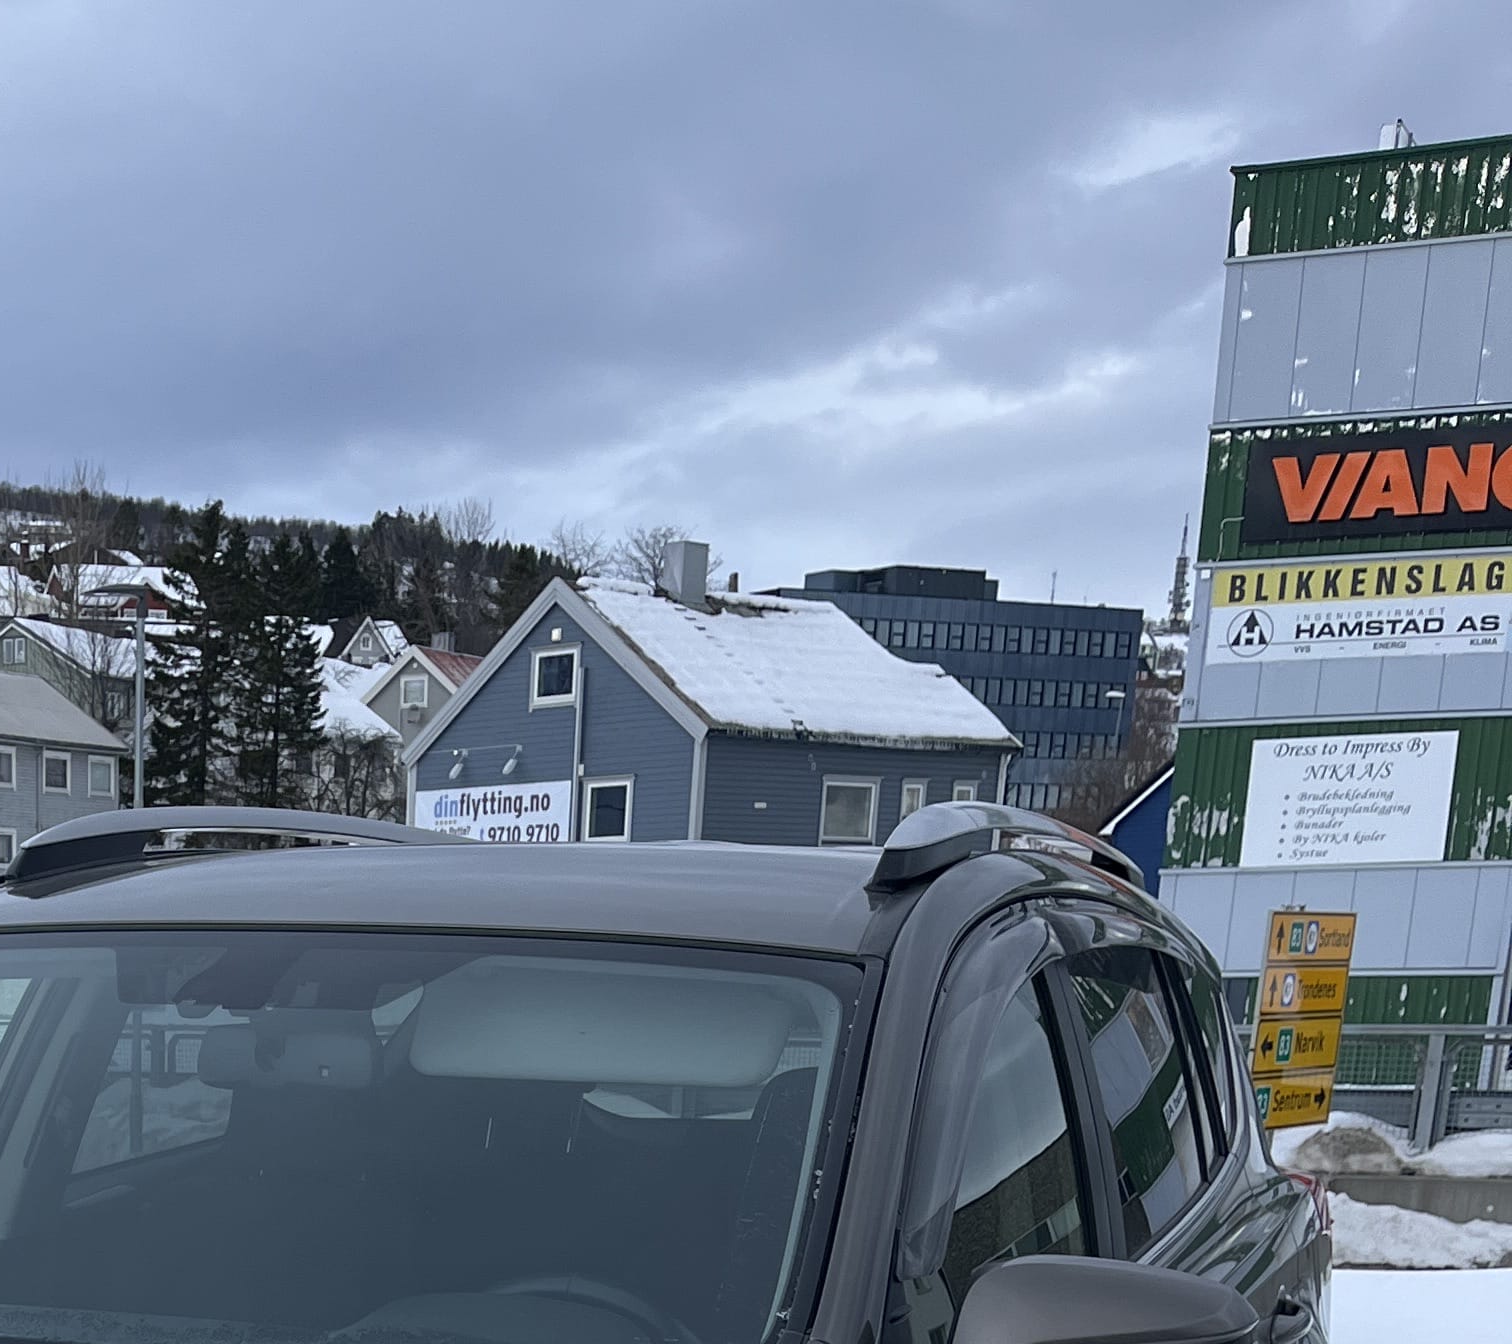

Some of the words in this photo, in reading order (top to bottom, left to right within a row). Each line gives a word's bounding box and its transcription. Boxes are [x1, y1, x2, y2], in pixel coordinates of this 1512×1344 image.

[1228, 560, 1506, 603] BLIKKENSLAG
[1295, 617, 1445, 639] HAMSTAD
[1456, 615, 1500, 632] AS
[1294, 645, 1311, 653] VVS
[1372, 641, 1407, 650] ENERGI
[1469, 637, 1498, 647] KLIMA
[1273, 742, 1318, 758] Dress
[1322, 743, 1338, 755] to
[1342, 740, 1404, 759] Impress
[1406, 737, 1431, 758] By
[1303, 763, 1355, 782] NIKA
[1357, 760, 1394, 781] A/S
[1297, 787, 1395, 802] Brudebekledning
[434, 790, 551, 821] dinflytting.no
[1295, 802, 1412, 818] Bryllupsplanlegging
[488, 825, 521, 842] 9710
[526, 823, 560, 842] 9710
[1294, 818, 1344, 830] Bunader
[1292, 834, 1309, 846] By
[1312, 832, 1349, 844] NIKA
[1289, 848, 1328, 860] Systue
[1291, 927, 1303, 948] 83
[1319, 928, 1351, 948] Sortland
[1298, 979, 1337, 1000] Trondenes
[1278, 1034, 1291, 1057] 83
[1295, 1030, 1325, 1053] Narvik
[1272, 1088, 1311, 1112] Sentrum
